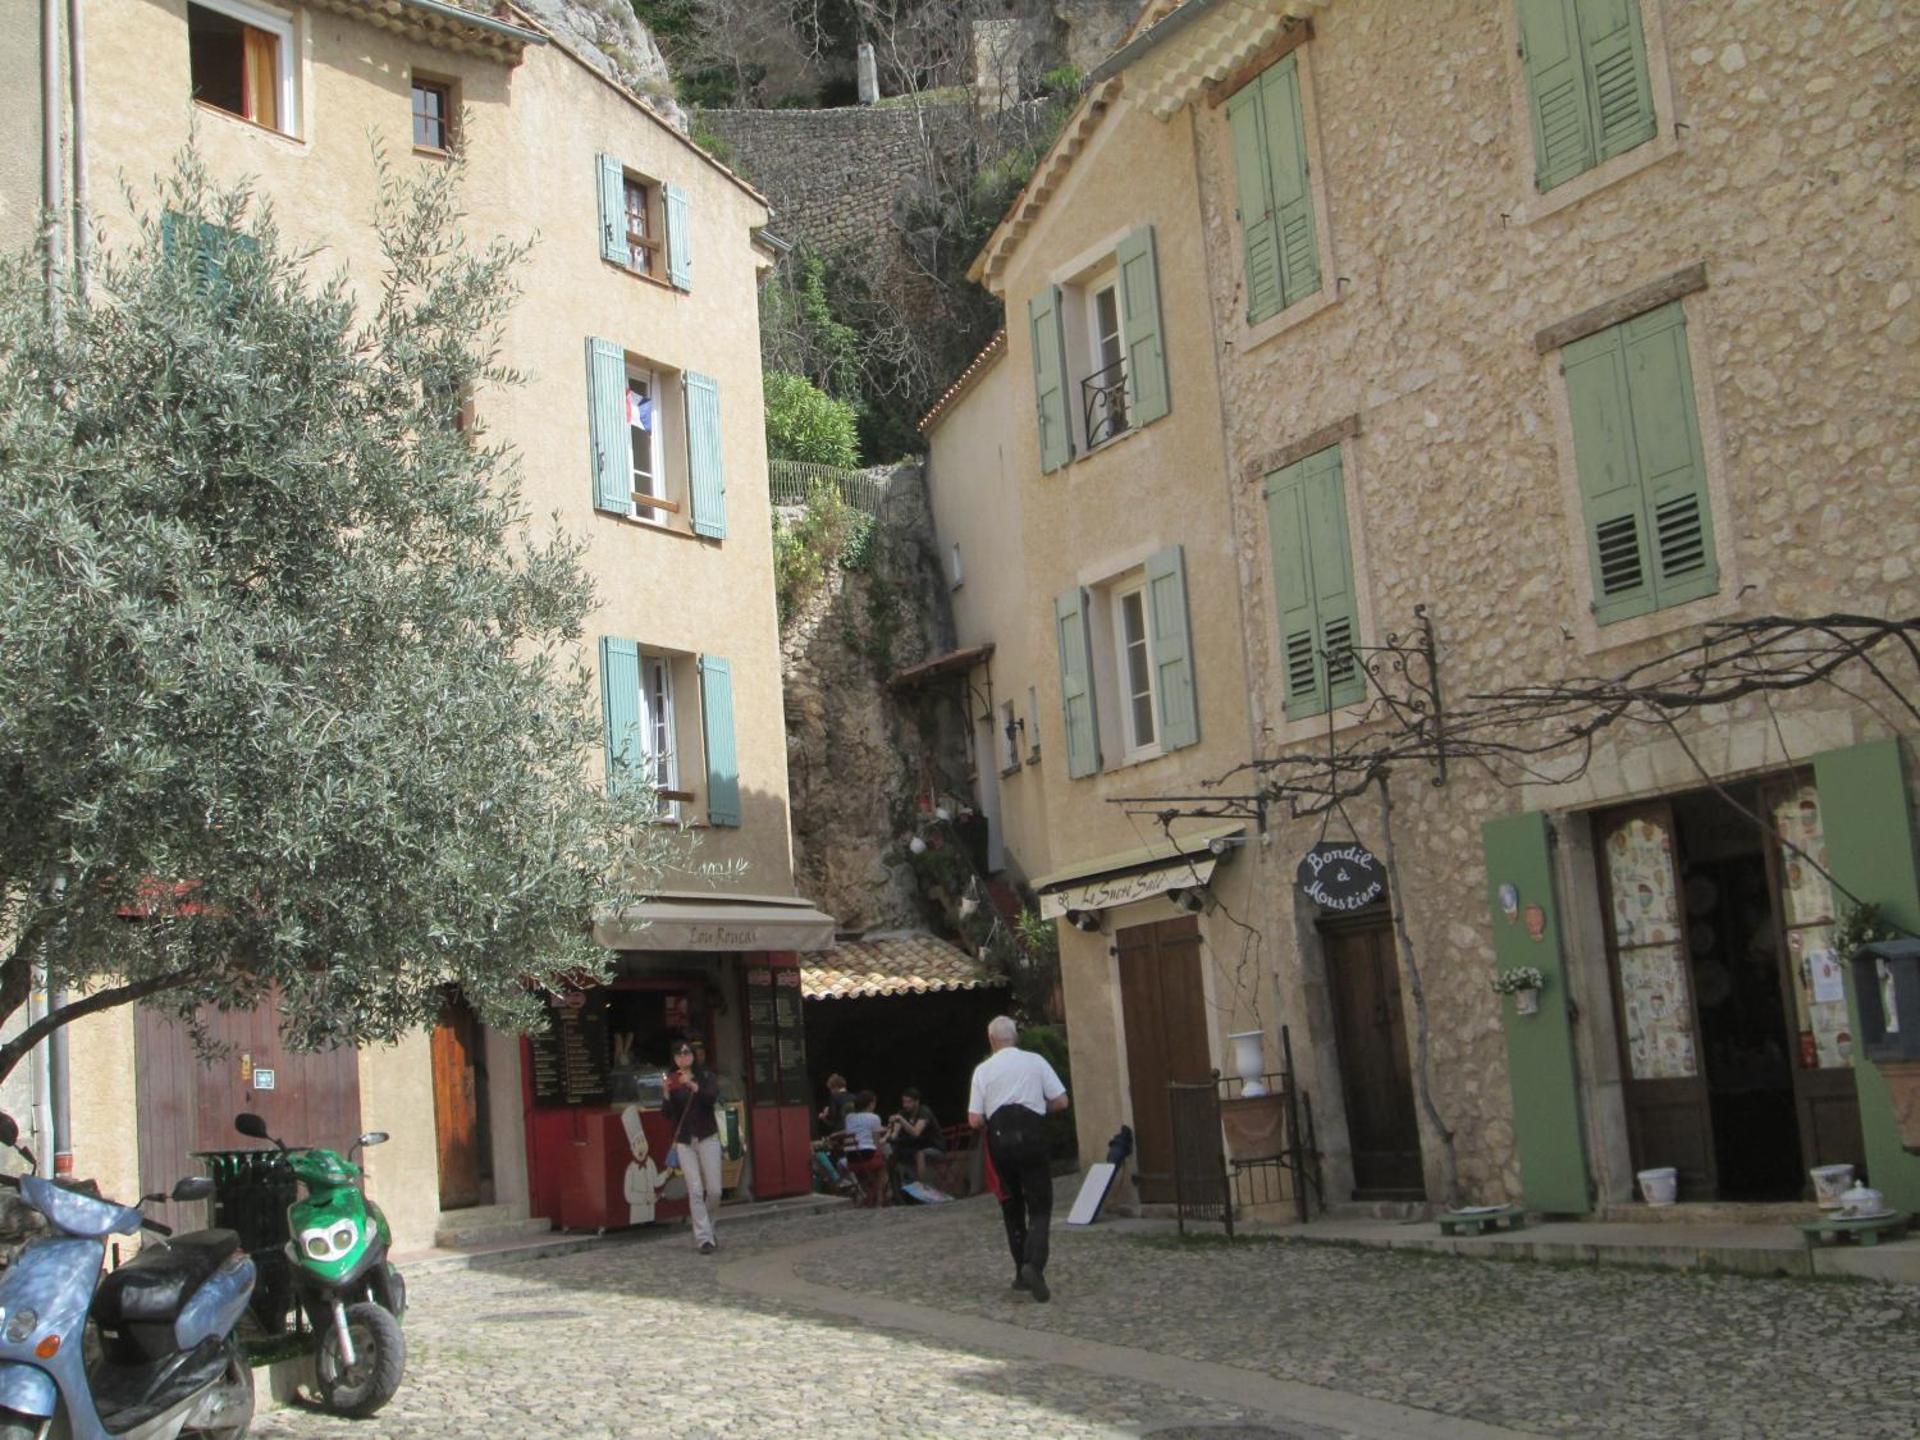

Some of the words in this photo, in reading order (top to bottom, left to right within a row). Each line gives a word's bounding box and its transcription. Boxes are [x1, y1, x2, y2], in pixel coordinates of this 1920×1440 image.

[1307, 846, 1373, 877] Bondil
[1336, 867, 1351, 882] à
[1303, 880, 1382, 910] Moustiers
